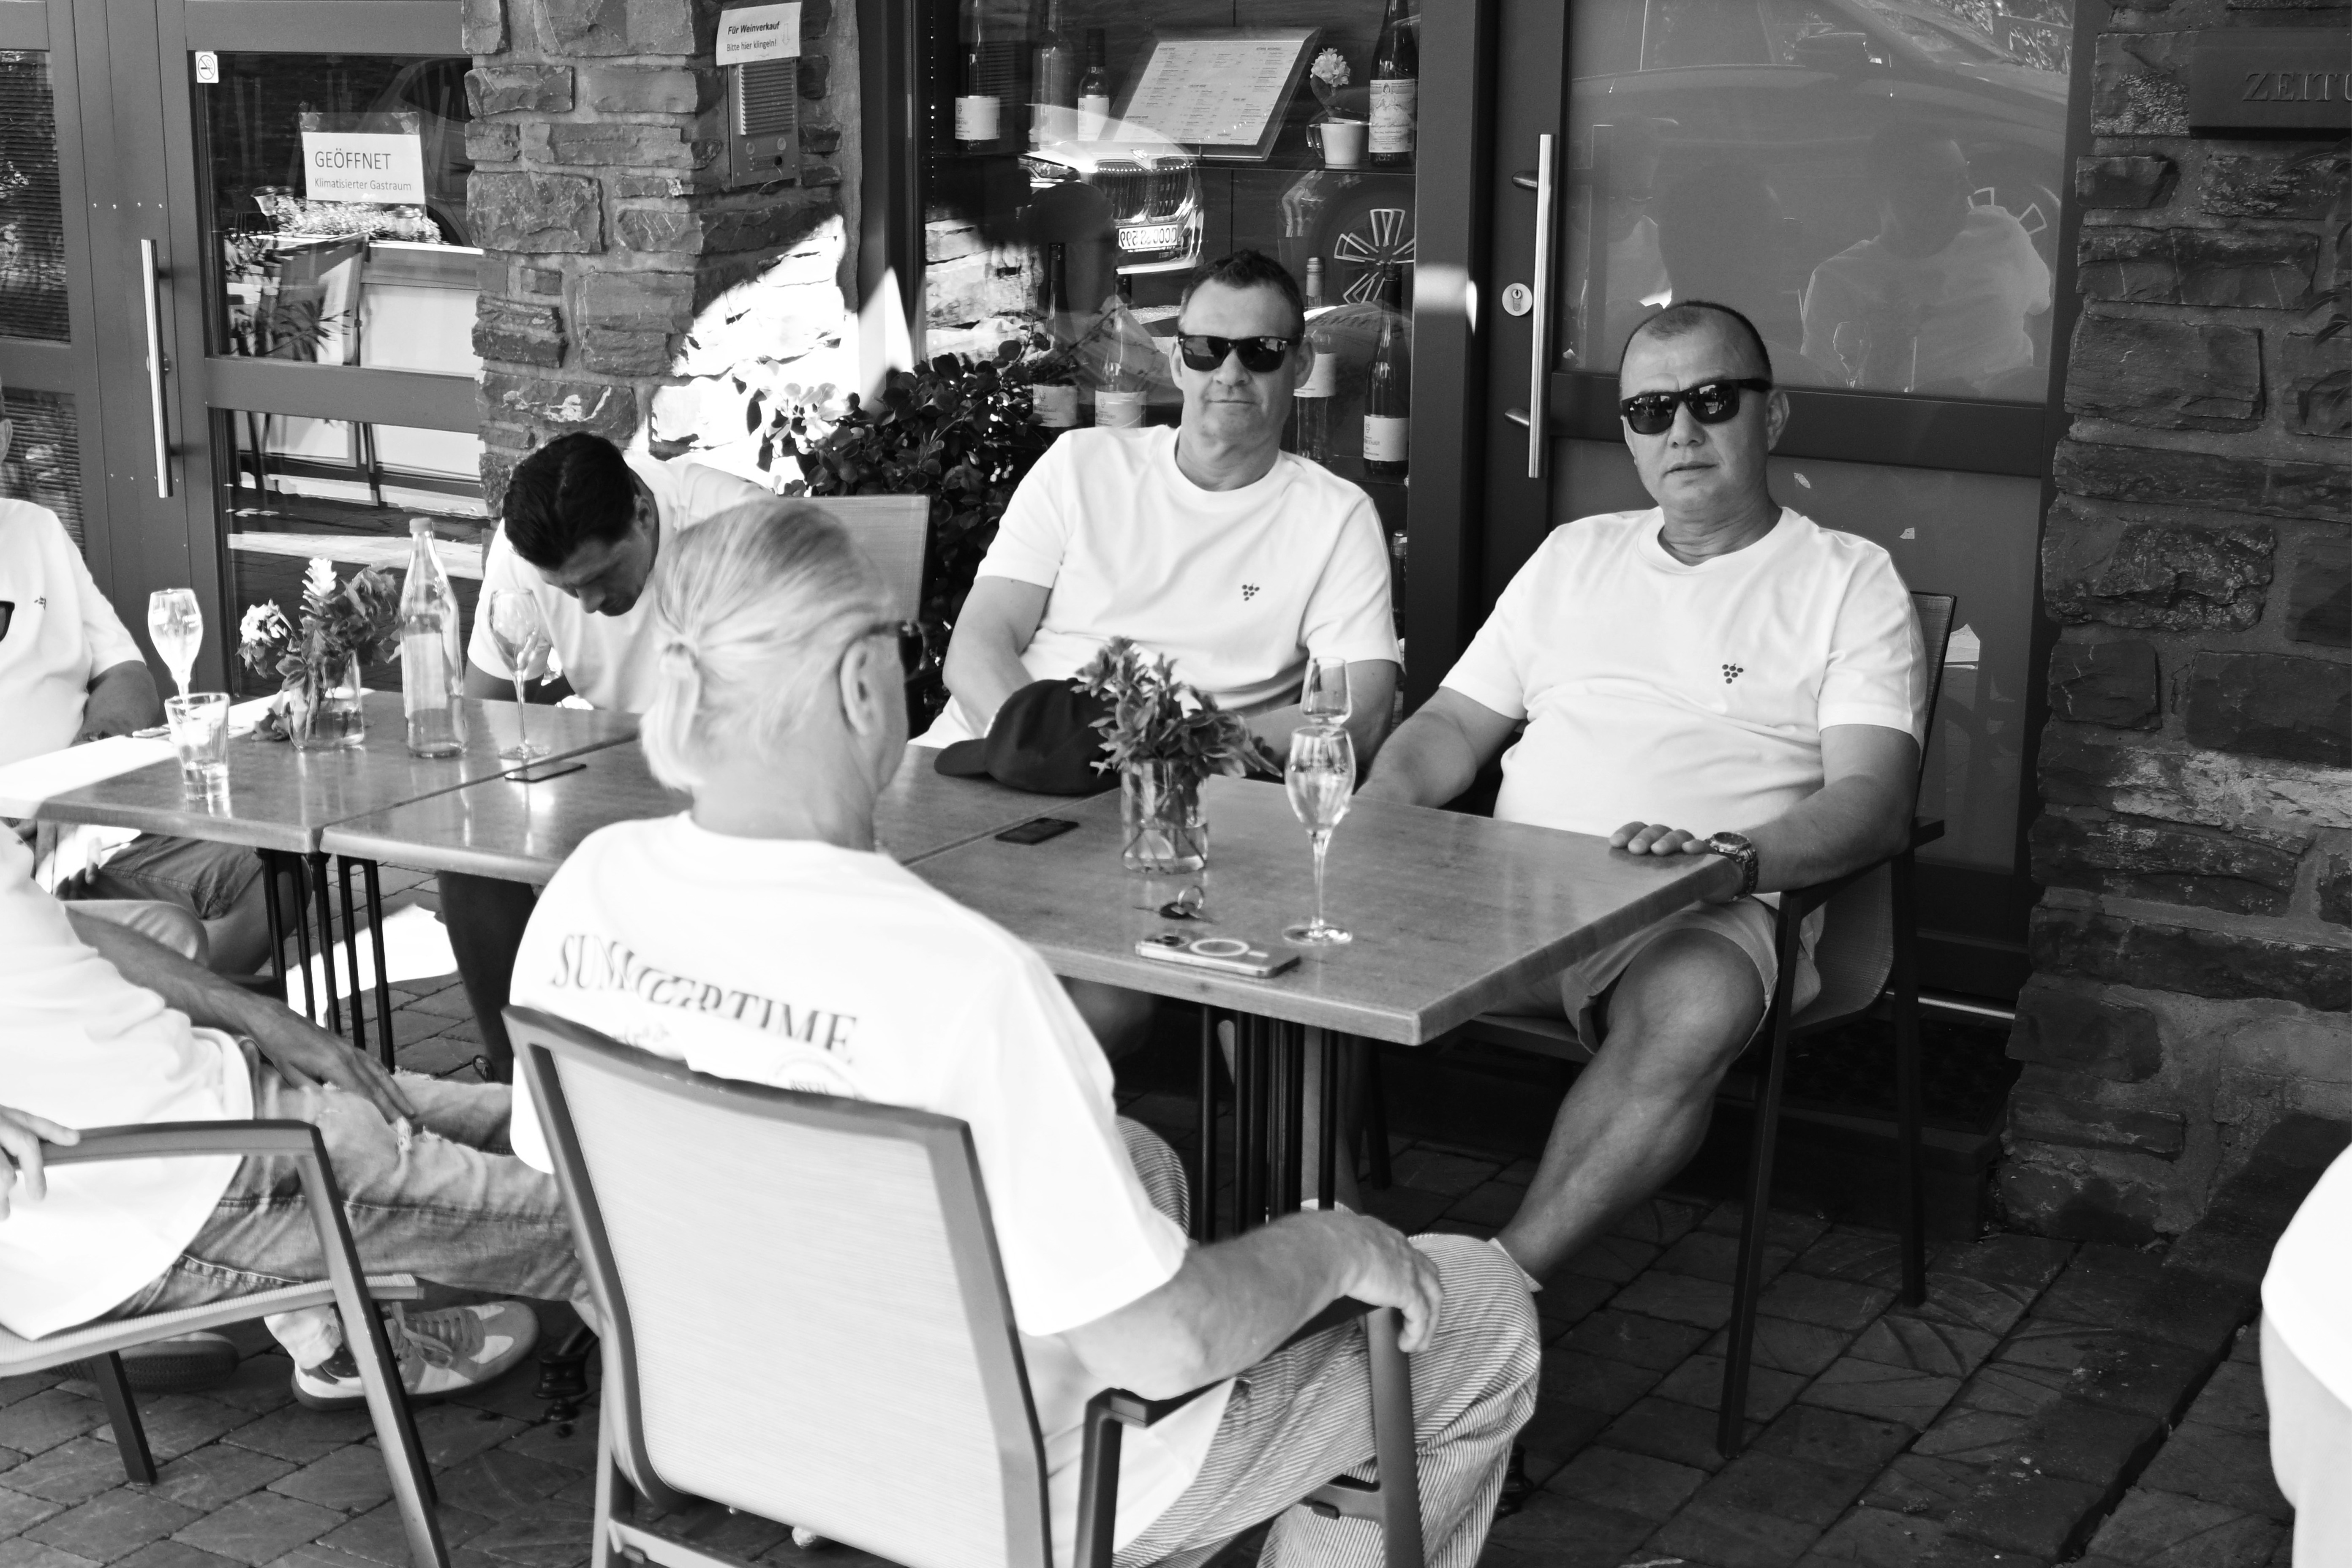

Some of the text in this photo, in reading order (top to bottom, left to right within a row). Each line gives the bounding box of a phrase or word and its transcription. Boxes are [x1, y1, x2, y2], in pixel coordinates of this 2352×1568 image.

[728, 21, 780, 35] Für Weinverkauf
[741, 41, 752, 50] hier
[754, 39, 776, 49] klingeln!
[315, 148, 391, 169] GEÖFFNET
[315, 178, 411, 191] Klimatisierter Gastraum
